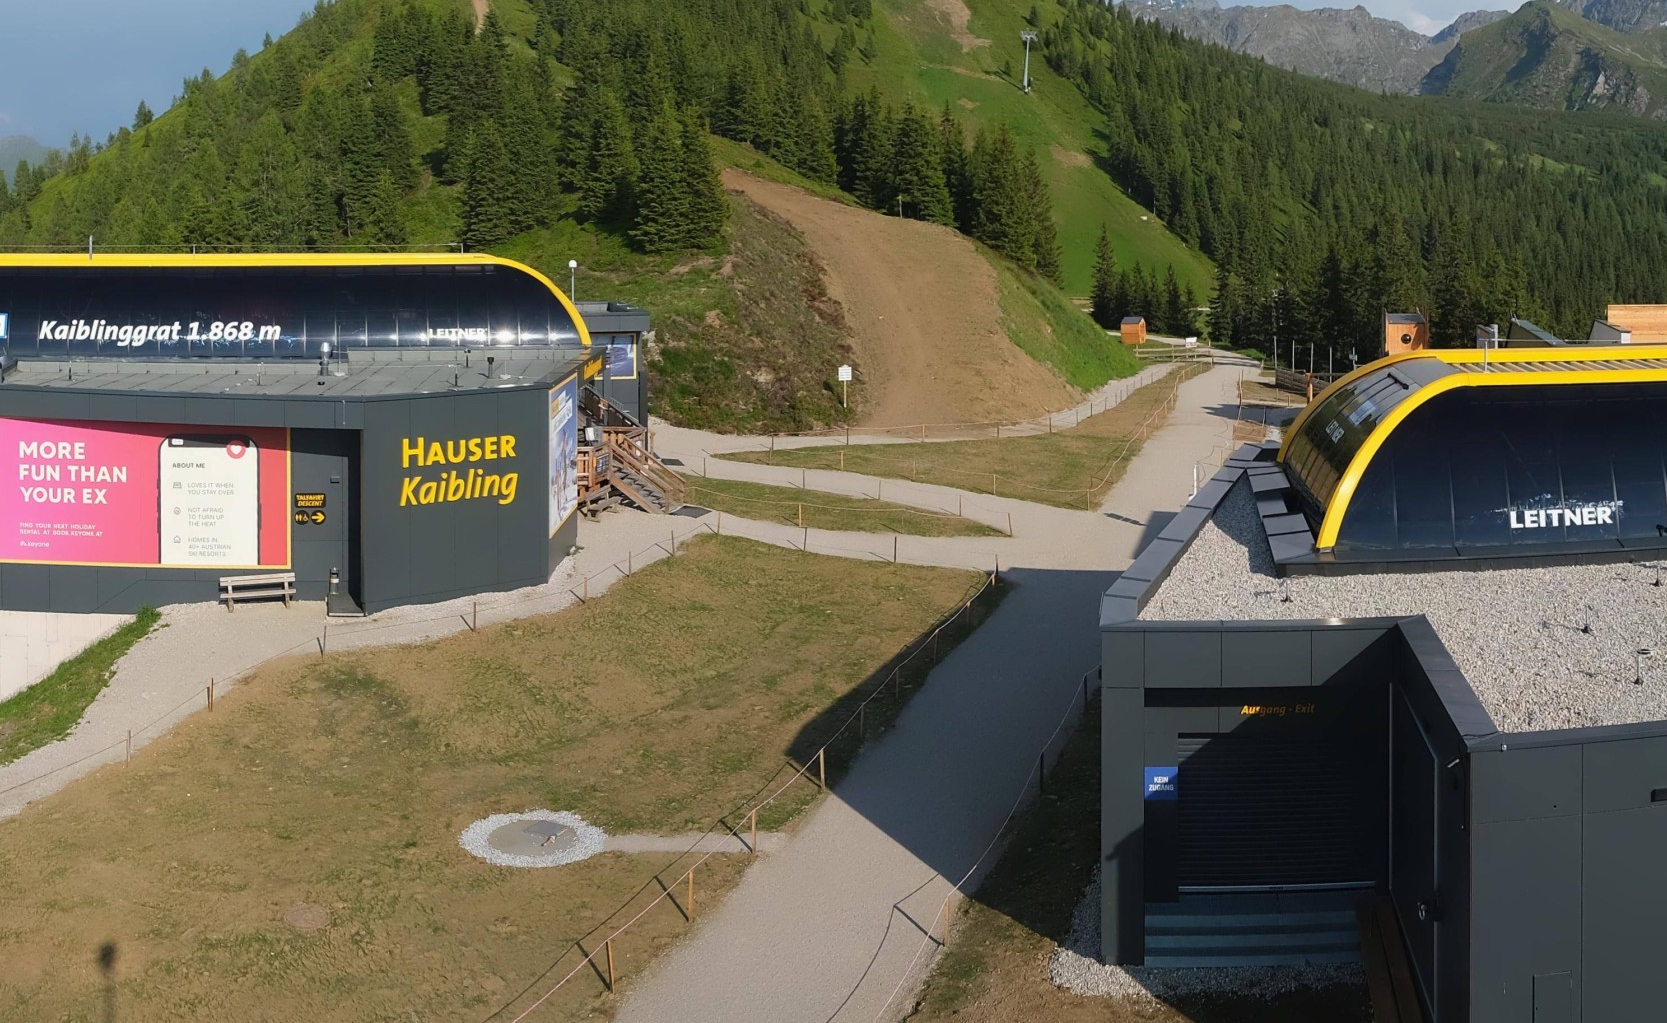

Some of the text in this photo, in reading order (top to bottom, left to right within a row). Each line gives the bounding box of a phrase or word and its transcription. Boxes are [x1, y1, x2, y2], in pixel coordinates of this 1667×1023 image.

[39, 319, 281, 347] Kaiblinggrat 1.868 m
[429, 328, 485, 338] LEITNER
[19, 441, 85, 459] MORE
[402, 435, 516, 468] HAUSER
[19, 464, 127, 483] FUN THAN
[20, 486, 108, 504] YOUR EX
[400, 468, 518, 506] Kaibling
[1510, 506, 1613, 529] LEITNER
[1240, 705, 1286, 717] Ausgang
[1295, 703, 1315, 713] Exit
